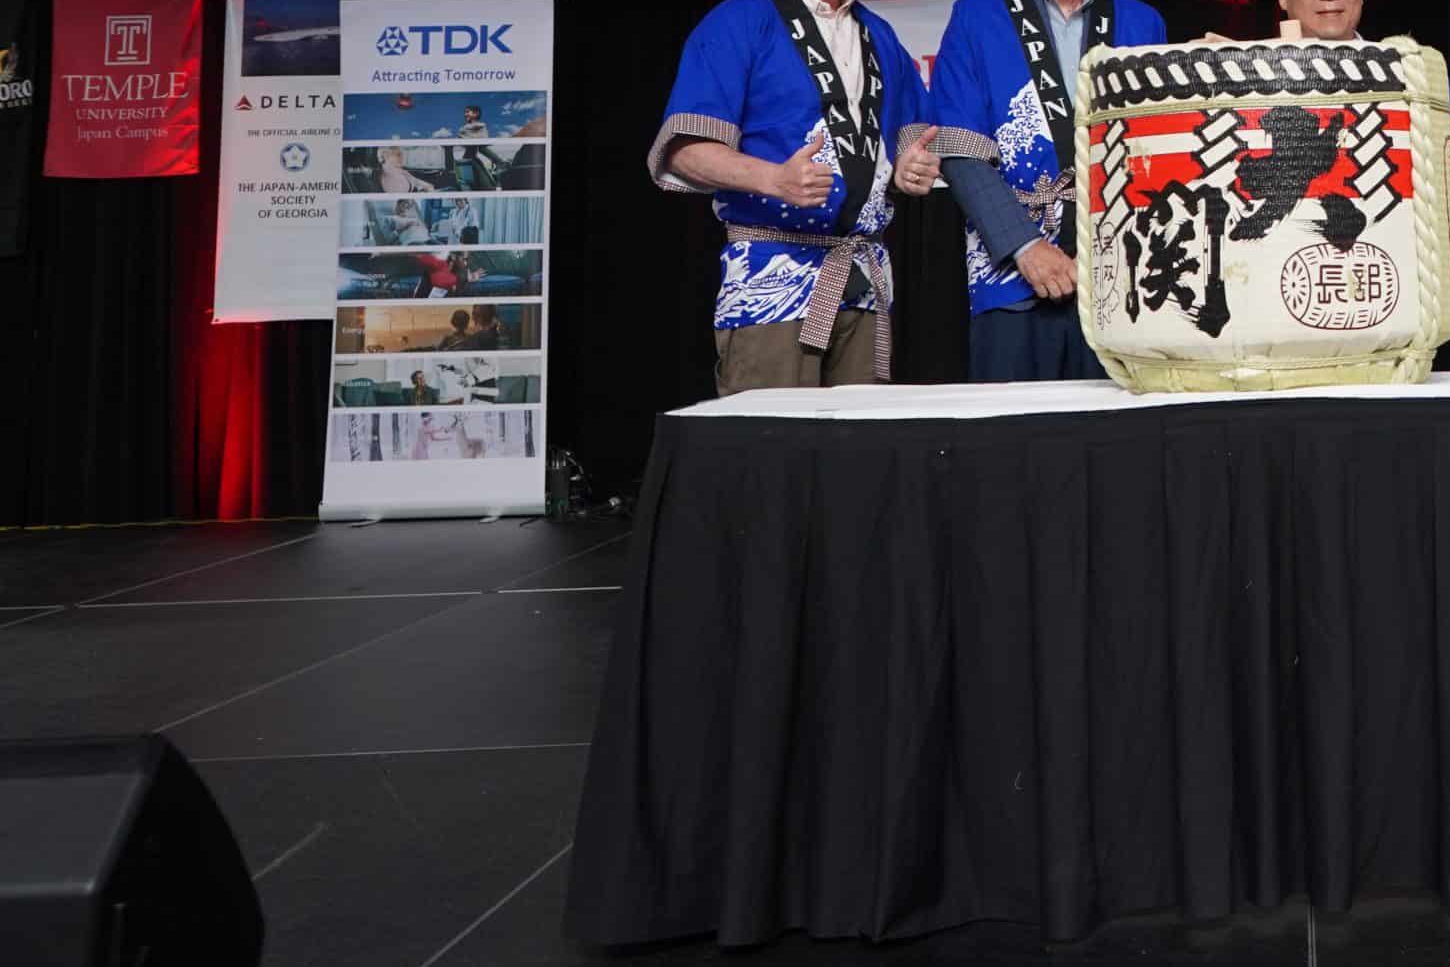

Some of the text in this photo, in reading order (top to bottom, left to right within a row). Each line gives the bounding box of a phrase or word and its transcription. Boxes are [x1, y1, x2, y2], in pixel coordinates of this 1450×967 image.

[407, 24, 514, 56] TDK
[371, 68, 516, 84] Attracting Tomorrow
[61, 71, 190, 102] TEMPLE
[791, 18, 856, 159] JAPAN
[260, 95, 336, 109] DELTA
[76, 106, 169, 121] UNIVERSITY
[238, 183, 256, 193] THE
[271, 195, 317, 206] SOCIETY
[257, 208, 329, 219] OF GEORGIA
